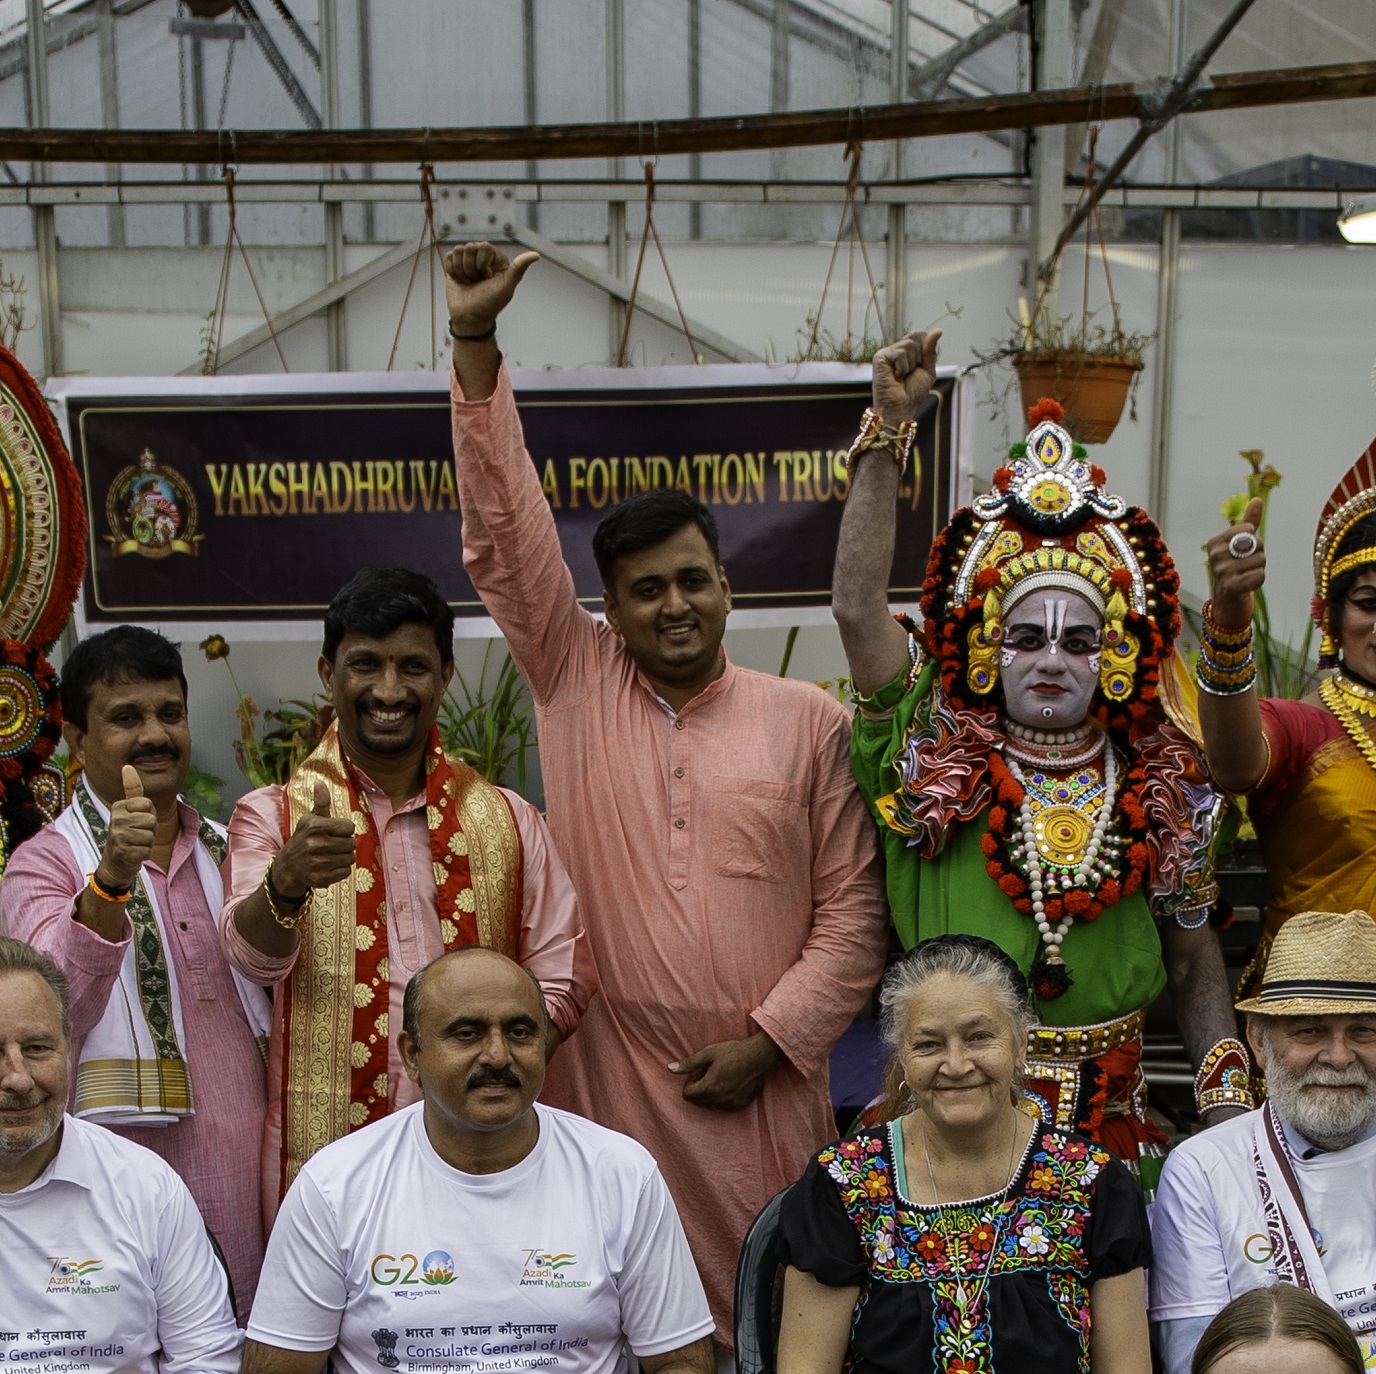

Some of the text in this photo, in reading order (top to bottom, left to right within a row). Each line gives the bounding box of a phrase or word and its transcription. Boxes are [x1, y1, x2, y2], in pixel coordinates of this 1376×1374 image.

[205, 460, 460, 516] YAKSHADHRUVA
[568, 452, 765, 509] FOUNDATION
[773, 448, 851, 502] TRUS
[371, 1250, 459, 1286] G20
[522, 1269, 564, 1280] Azadi Ka
[45, 1283, 121, 1295] Amrit Mahotsav
[48, 1275, 91, 1286] Azadi Ka
[520, 1278, 592, 1289] Amrit Mahotsav
[1334, 1287, 1366, 1301] प्रधान
[26, 1328, 87, 1346] कौंसुलावास
[405, 1321, 558, 1339] भारत का प्रधान कौंसुलावास
[9, 1347, 66, 1363] General
[70, 1345, 87, 1358] of
[90, 1344, 124, 1358] India
[406, 1336, 588, 1358] Consulate General of India
[44, 1360, 91, 1374] Kingdom
[408, 1355, 559, 1374] Birmingham, United Kingdom
